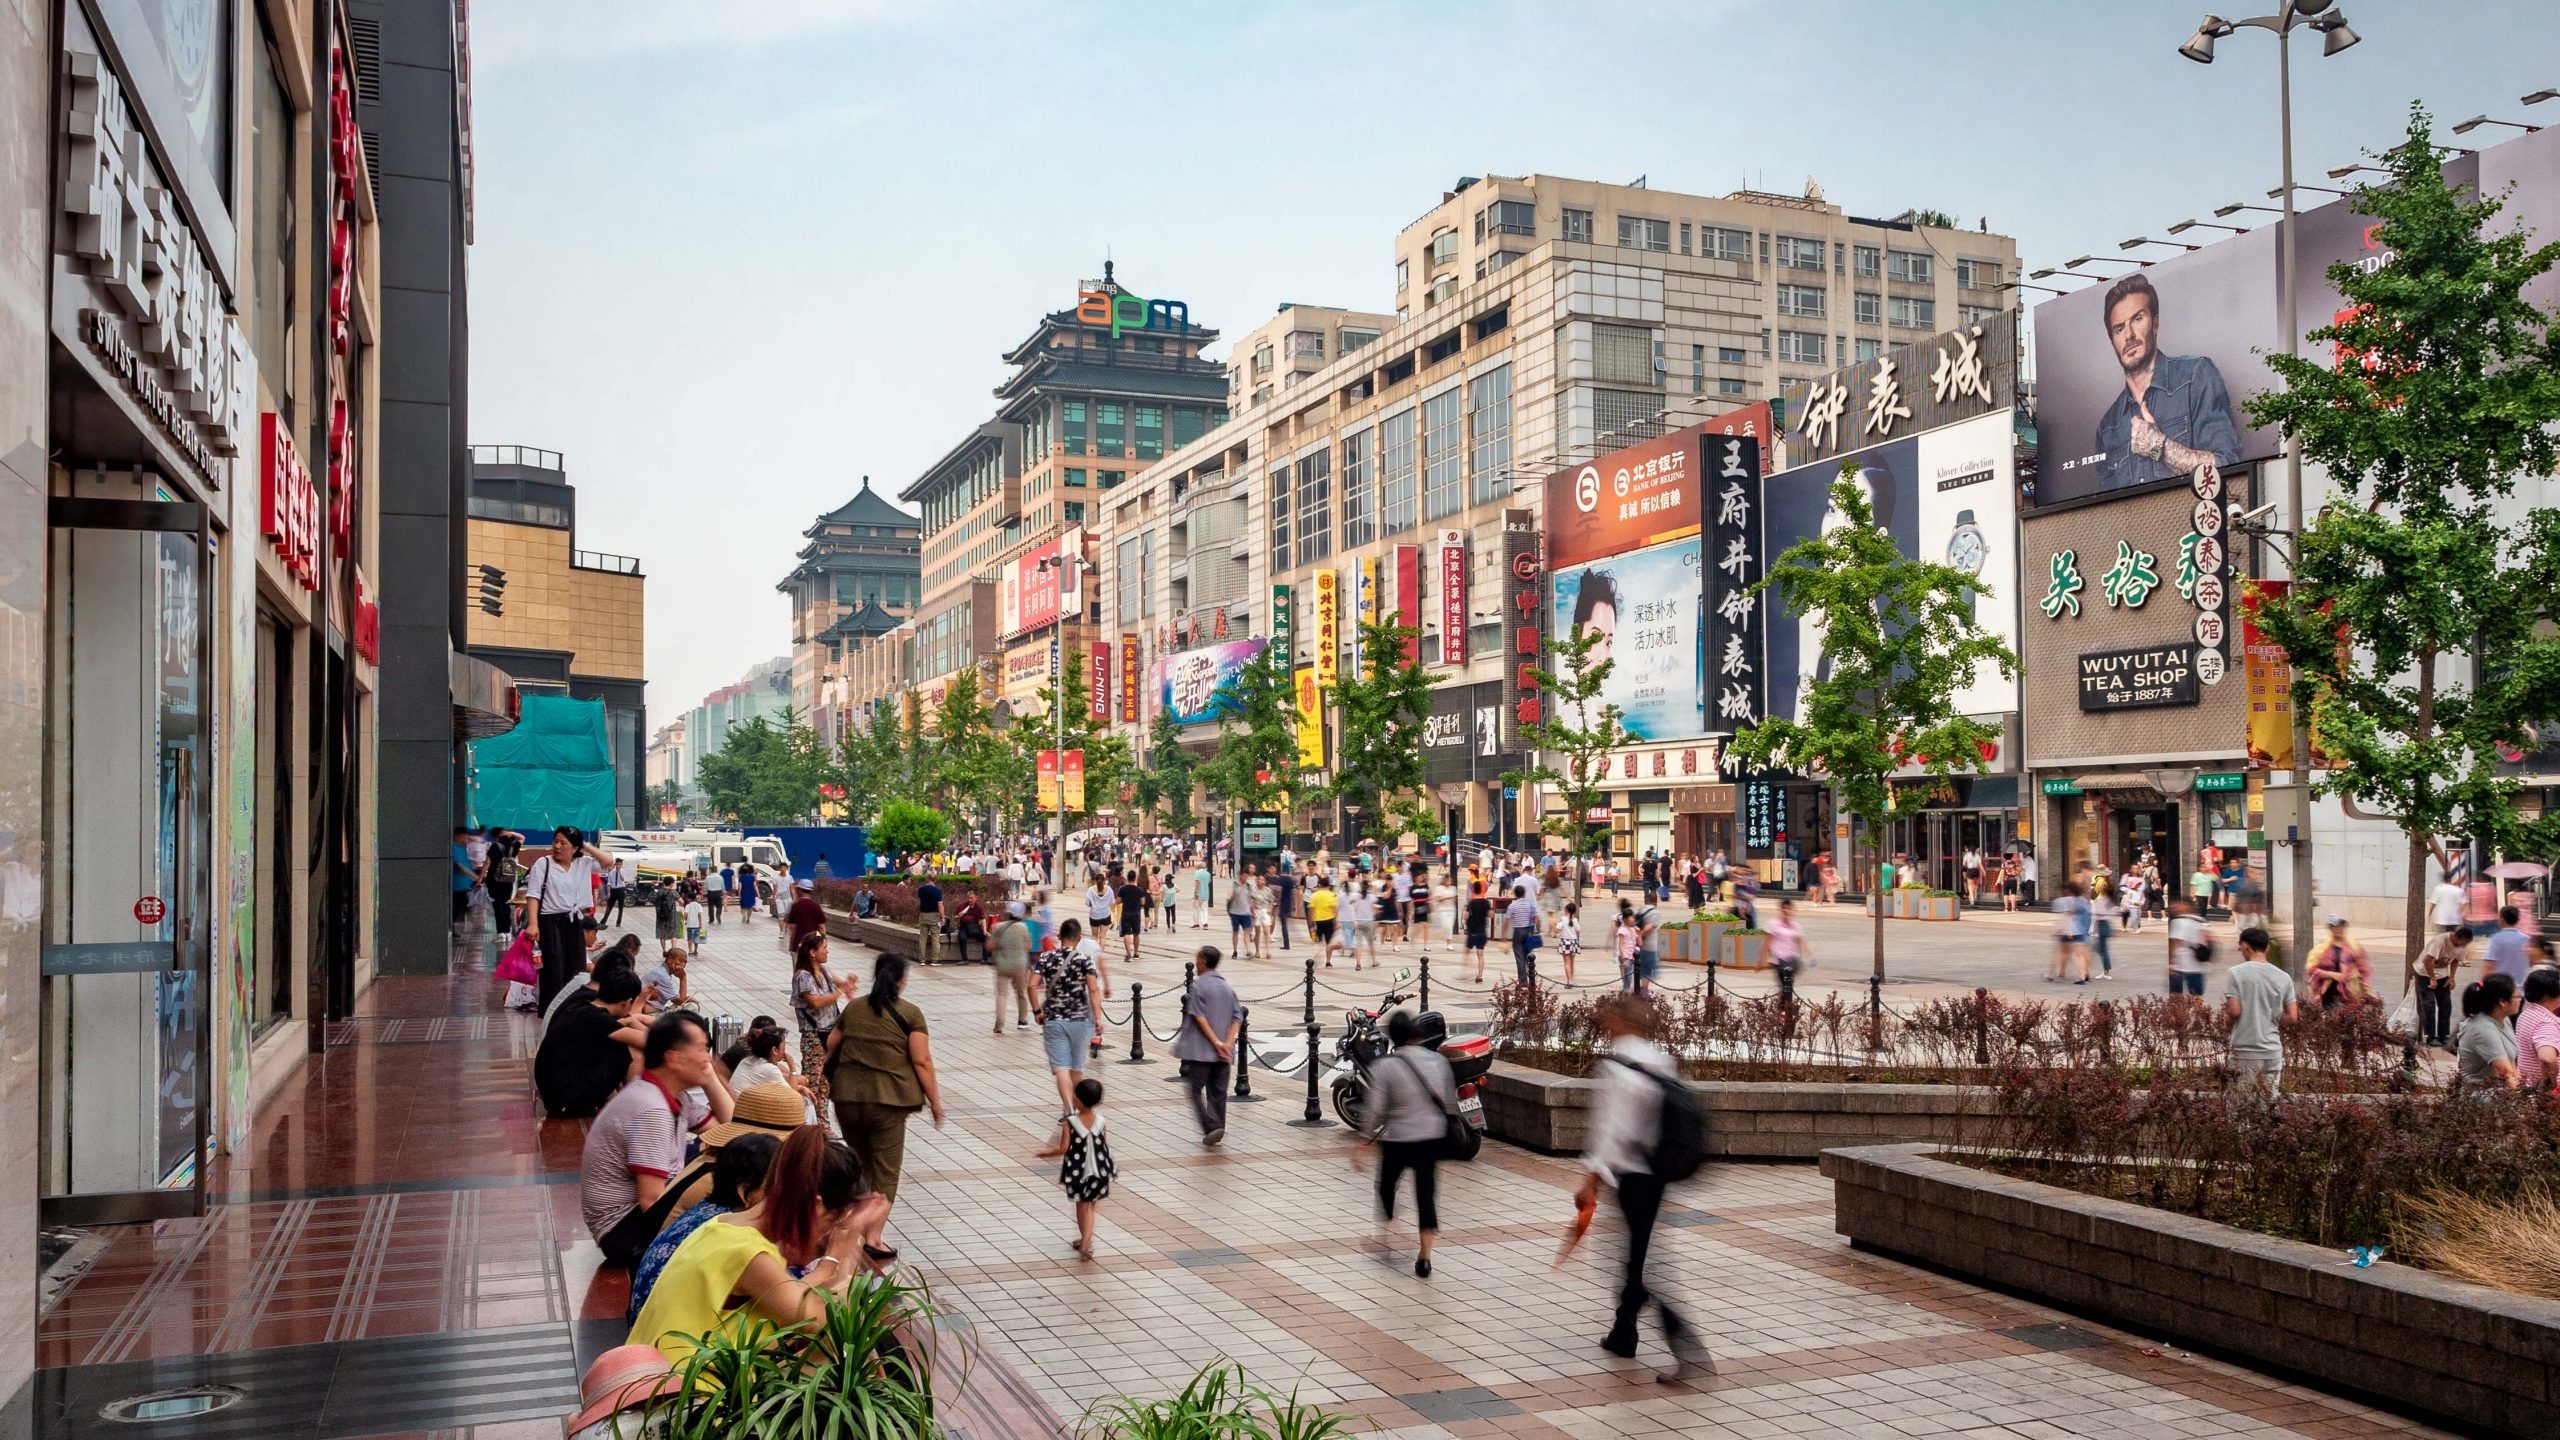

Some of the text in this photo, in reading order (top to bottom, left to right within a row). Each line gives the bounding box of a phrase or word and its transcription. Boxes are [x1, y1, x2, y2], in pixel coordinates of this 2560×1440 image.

[78, 52, 240, 455] 瑞士表维修店
[1077, 291, 1188, 338] apm
[97, 311, 222, 492] SWISS WATCH REPAIR STORE
[1797, 326, 1992, 450] 钟表城
[1633, 451, 1685, 481] 北京银行
[1960, 457, 1994, 474] Collection
[1633, 470, 1685, 492] BANK OF BEIJING
[1619, 488, 1681, 520] 真诚 所以信赖
[2199, 464, 2222, 640] 吴裕泰茶馆
[1718, 440, 1757, 727] 王府井钟表城
[1450, 549, 1462, 662] 北京全聚德王府井店
[1634, 599, 1677, 625] 深透补水
[1320, 591, 1333, 669] 北京同仁堂
[1635, 626, 1678, 650] 活力冰肌
[2083, 649, 2188, 673] WUYUTAI
[2203, 669, 2219, 680] 2F
[1095, 656, 1105, 714] LI-NING
[2083, 668, 2188, 691] TEA SHOP
[2107, 687, 2174, 703] 始于1887年
[1437, 735, 1465, 746] HENGDELI
[641, 834, 676, 842] 东城环卫
